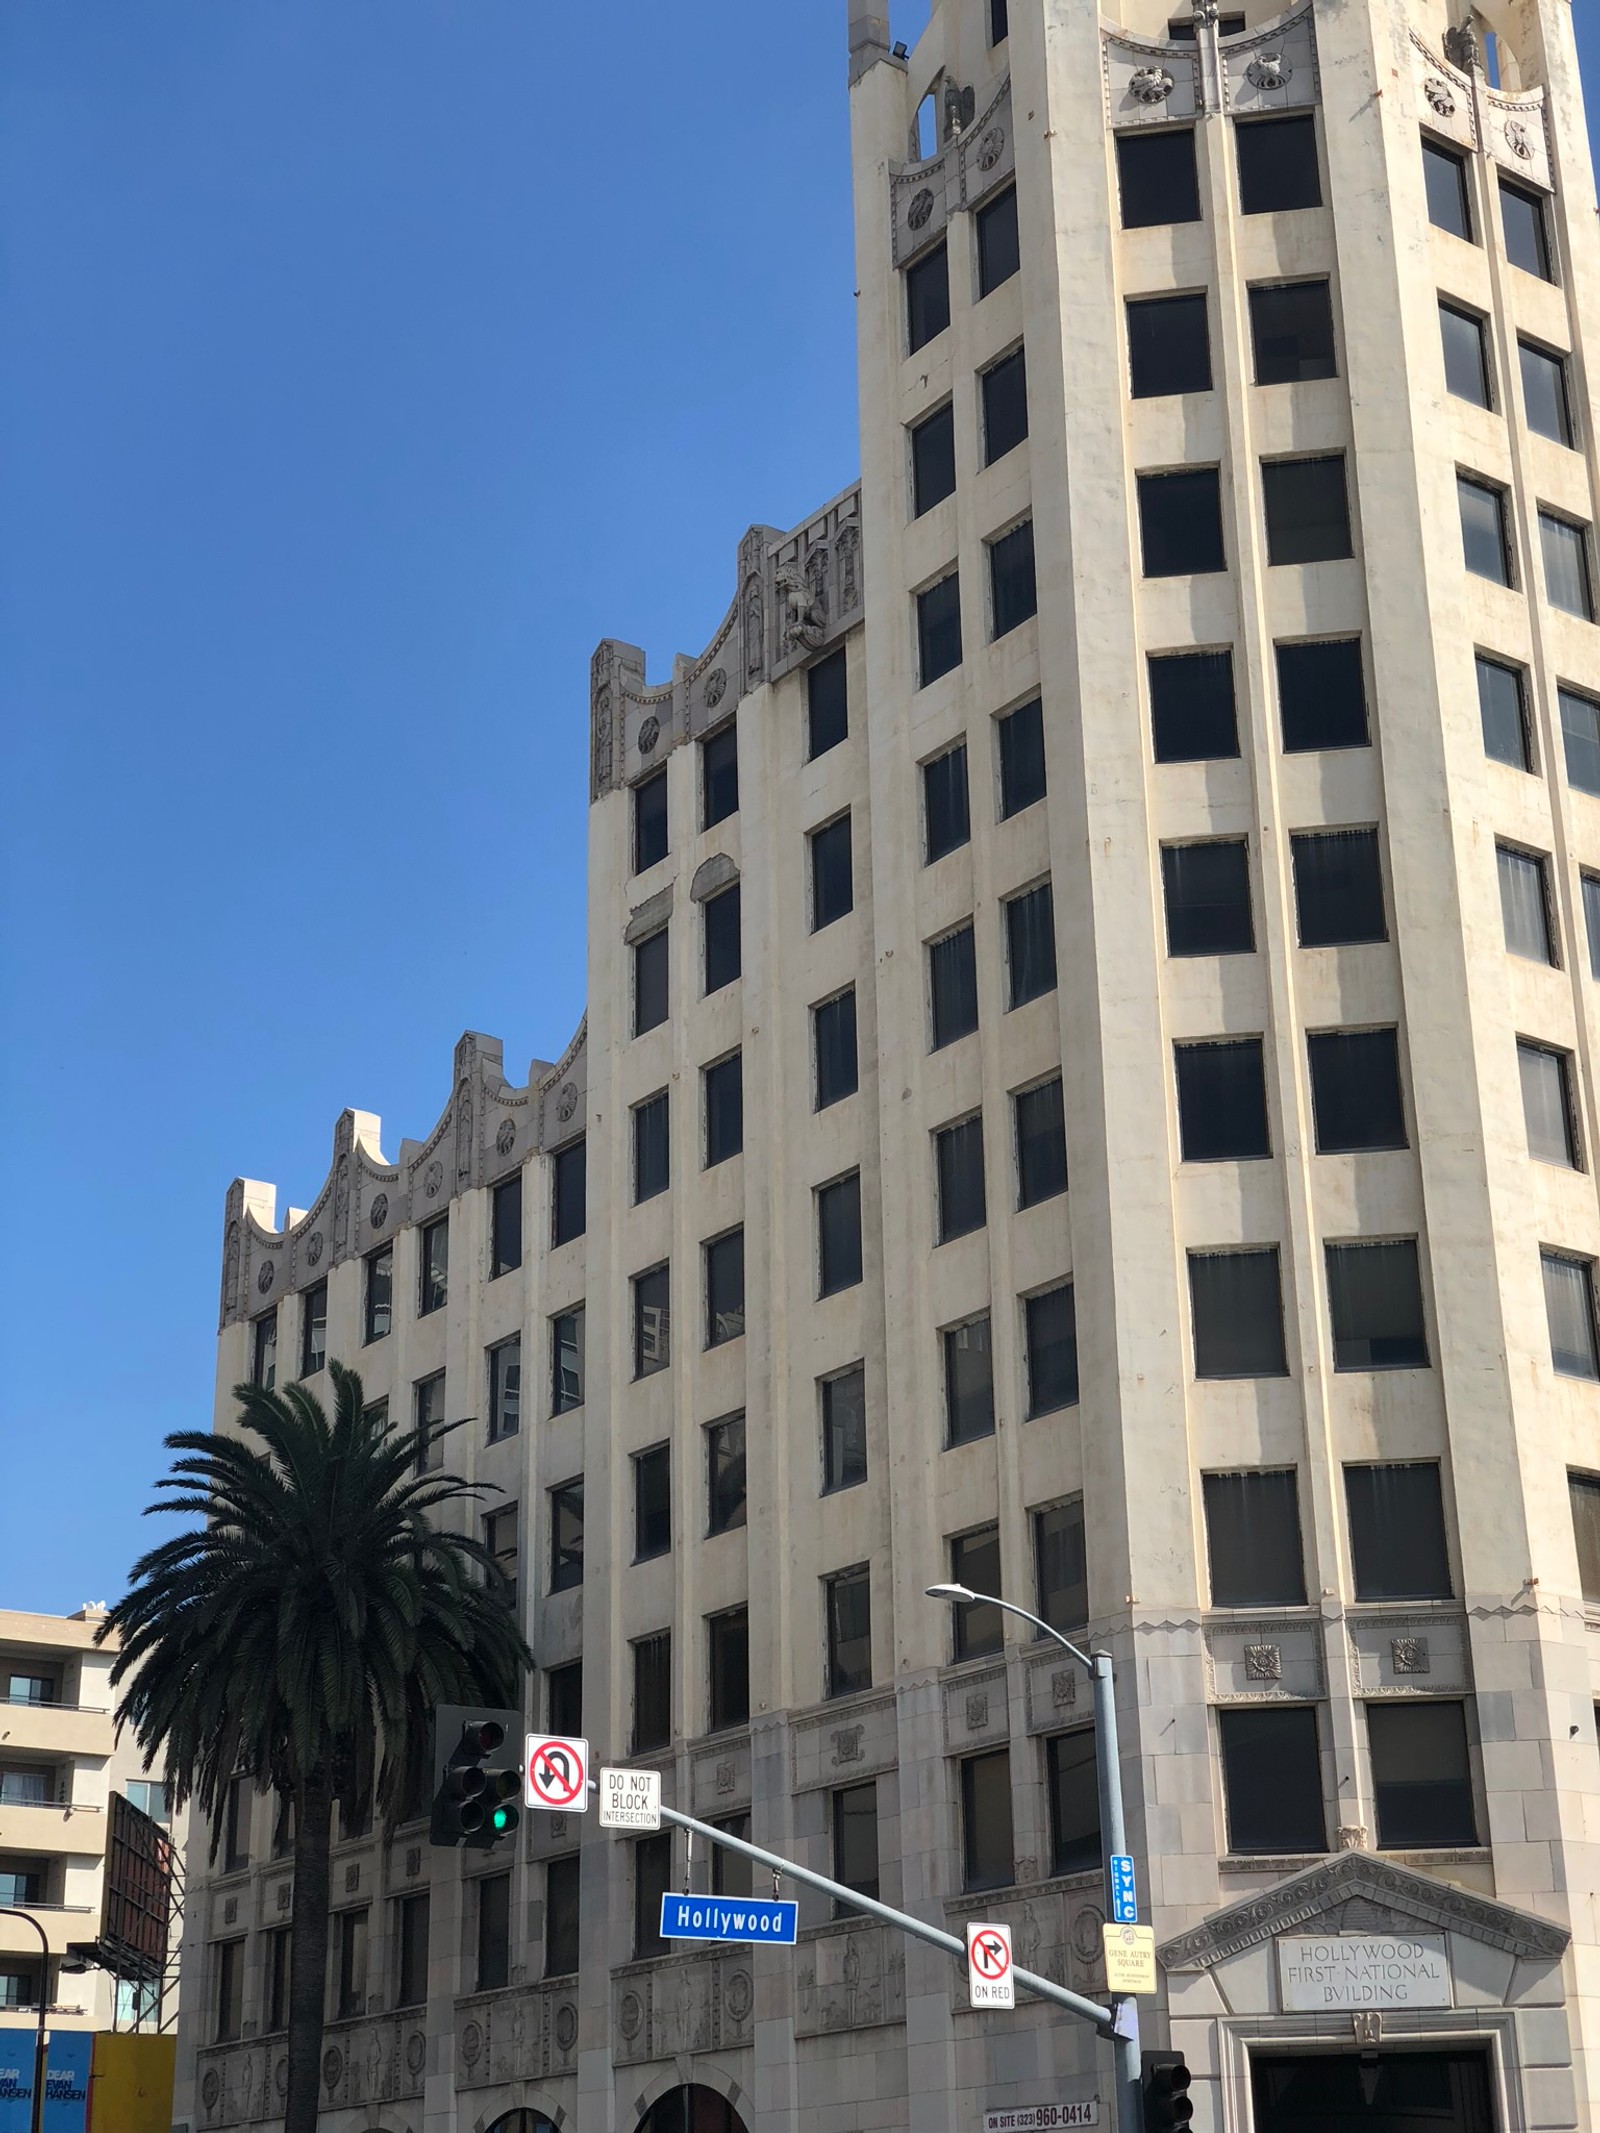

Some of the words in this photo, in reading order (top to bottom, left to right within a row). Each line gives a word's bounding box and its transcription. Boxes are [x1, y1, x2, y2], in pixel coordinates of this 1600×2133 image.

[609, 1774, 625, 1791] DO
[630, 1775, 652, 1792] NOT
[612, 1792, 649, 1811] BLOCK
[603, 1810, 657, 1824] INTERSECTION
[1120, 1859, 1135, 1919] SYNC
[677, 1904, 783, 1935] Hollywood
[1108, 1949, 1128, 1958] GENE
[1130, 1950, 1152, 1960] AUTRY
[1300, 1942, 1425, 1963] HOLLYWOOD
[1117, 1958, 1145, 1969] SQUARE
[1287, 1965, 1336, 1983] FIRST
[1344, 1962, 1441, 1981] NATIONAL
[974, 1985, 989, 1999] ON
[991, 1986, 1010, 1999] RED
[46, 2069, 75, 2081] DEAR
[46, 2079, 73, 2091] EVAN
[45, 2088, 87, 2101] HANSEN
[988, 2117, 998, 2129] ON
[1000, 2115, 1015, 2128] SITE
[1017, 2112, 1036, 2127] (323)
[1036, 2103, 1092, 2127] 960-0414
